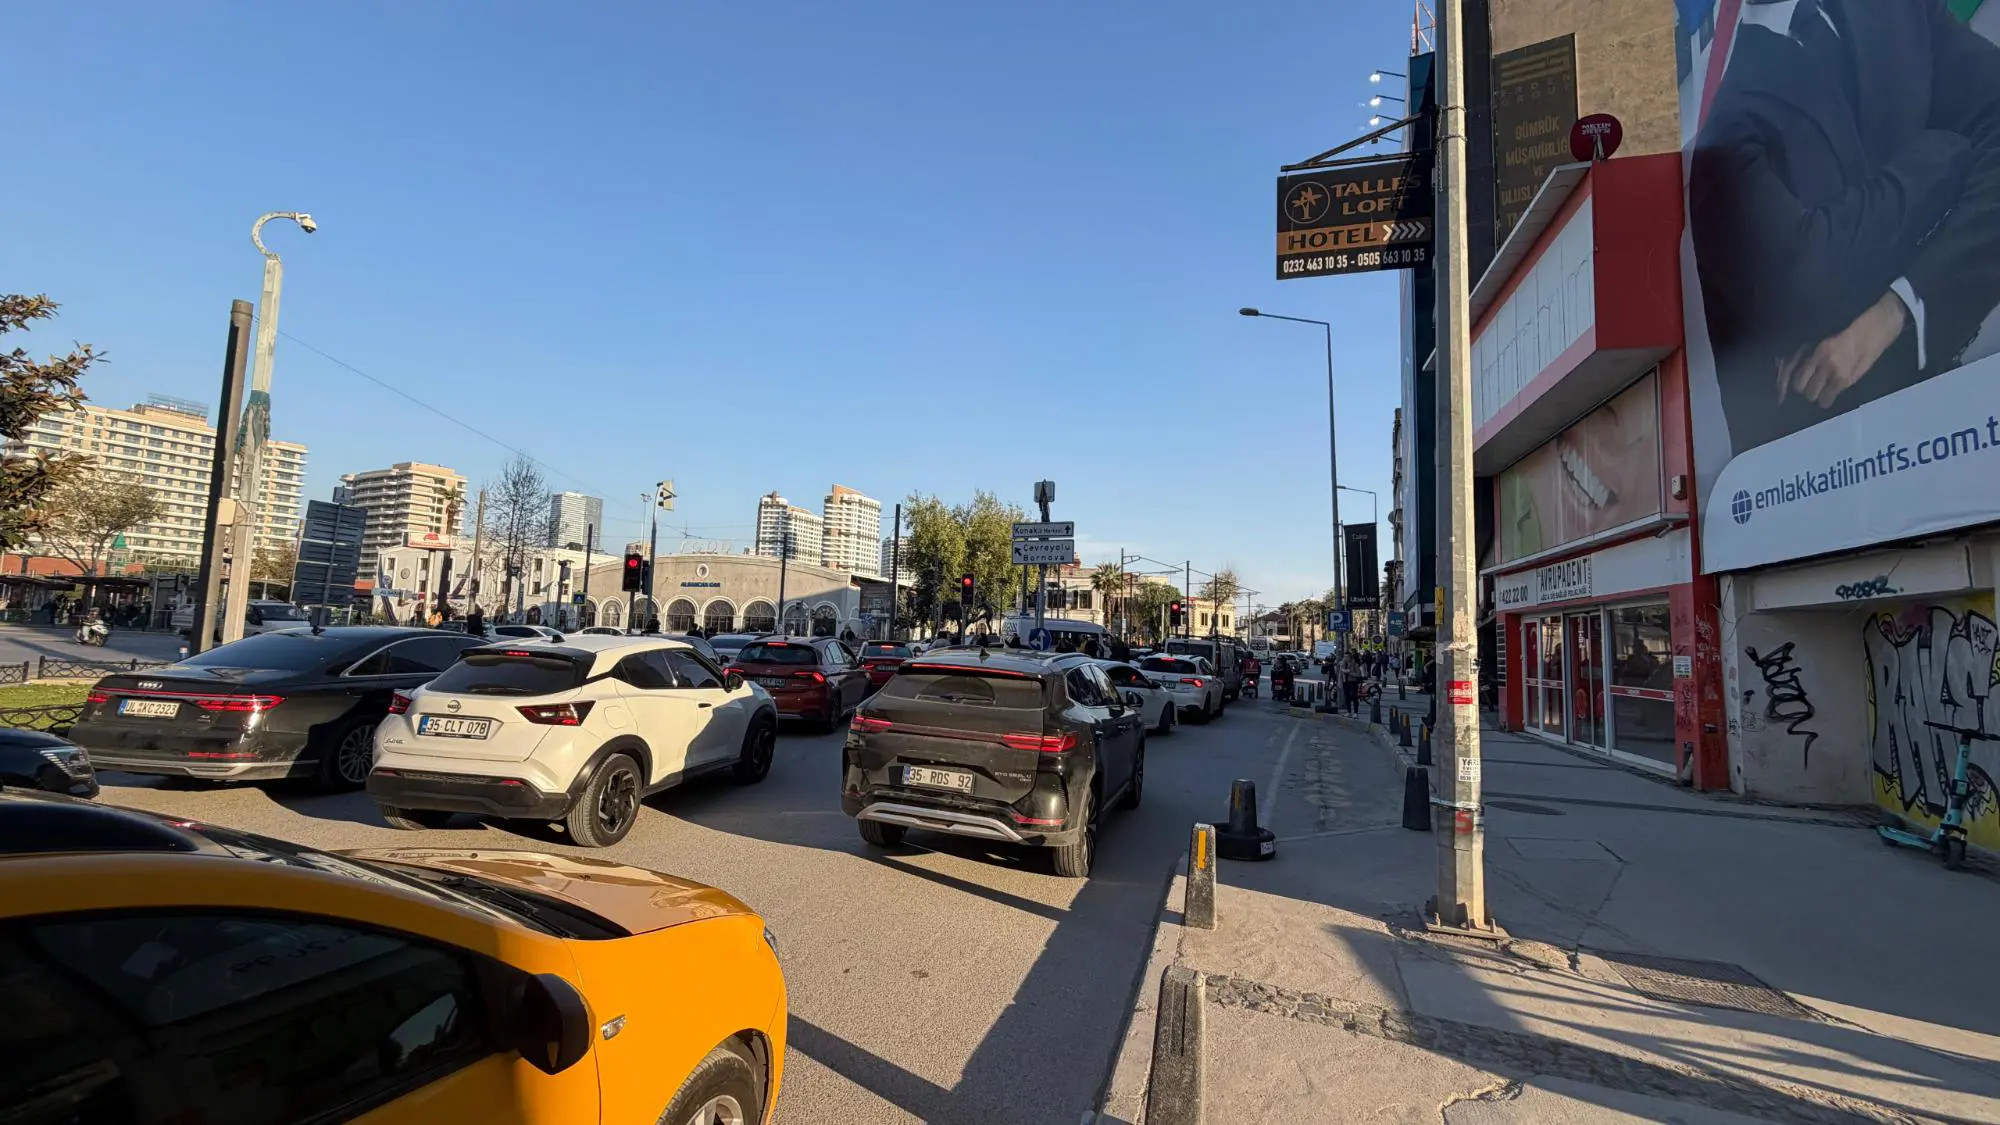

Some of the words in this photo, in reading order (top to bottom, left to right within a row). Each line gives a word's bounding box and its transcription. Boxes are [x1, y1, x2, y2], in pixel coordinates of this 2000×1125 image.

[1532, 165, 1544, 176] VE
[1330, 175, 1422, 198] TALLES
[1342, 195, 1409, 216] LOFT
[1288, 226, 1377, 250] HOTEL
[1283, 259, 1304, 273] 0232
[1307, 257, 1322, 271] 463
[1325, 256, 1334, 269] 10
[1336, 255, 1348, 268] 35
[1358, 252, 1380, 266] 0505
[1383, 250, 1399, 264] 663
[1402, 249, 1411, 262] 10
[1413, 248, 1425, 261] 35
[1540, 558, 1587, 592] AVRUPADENT
[1502, 588, 1512, 604] 422
[1512, 587, 1520, 602] 22
[1520, 584, 1528, 601] 00
[1330, 612, 1343, 629] P
[154, 704, 177, 715] 2323
[427, 719, 441, 731] 35
[444, 720, 464, 732] CLT
[466, 722, 487, 734] 078
[910, 768, 923, 781] 35
[929, 771, 950, 785] RDS
[958, 774, 972, 788] 92
